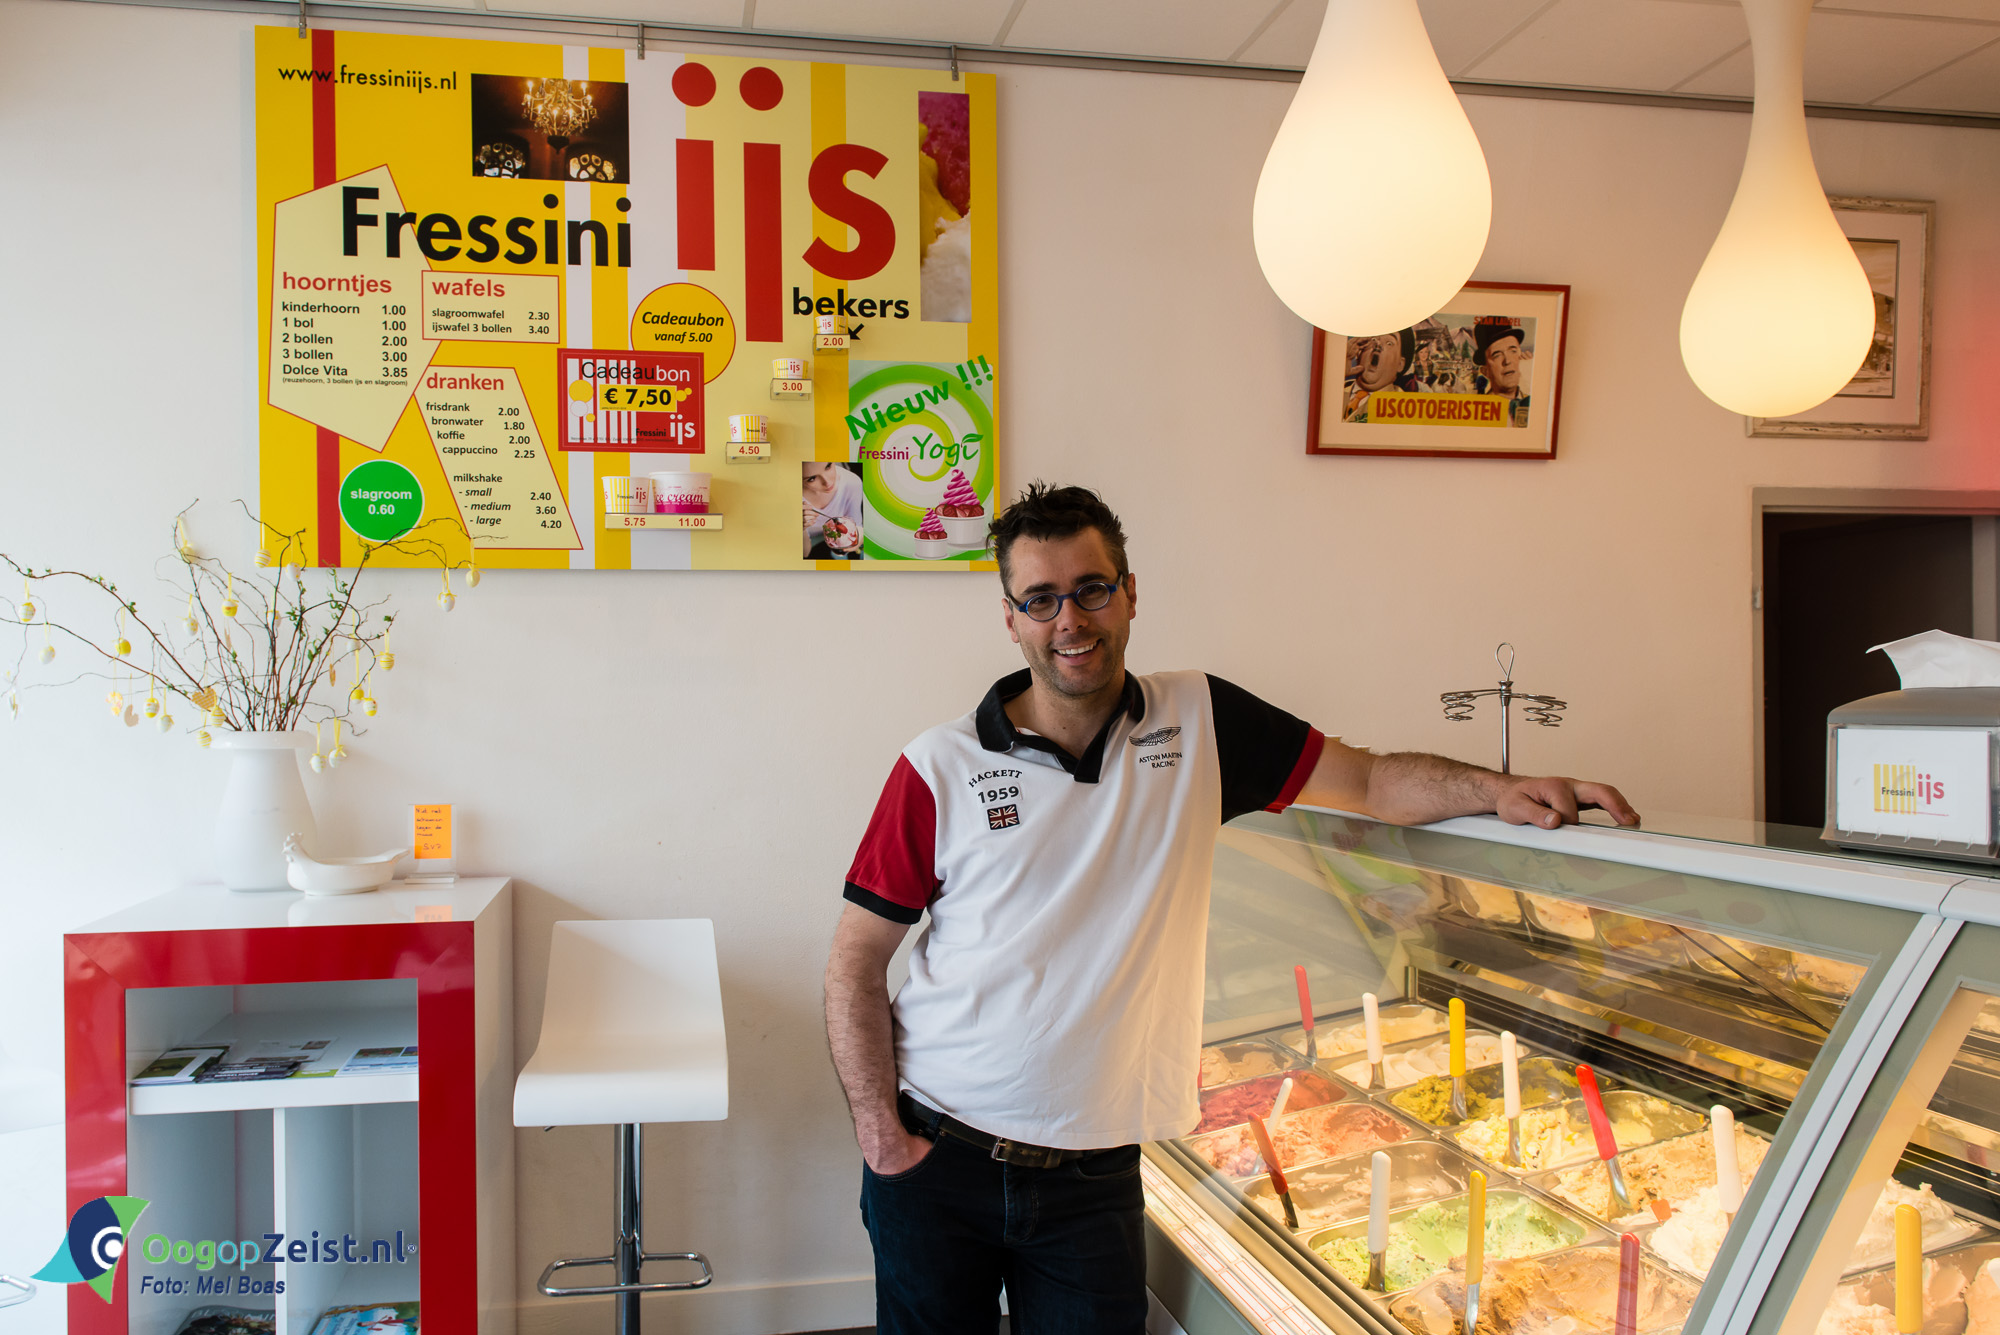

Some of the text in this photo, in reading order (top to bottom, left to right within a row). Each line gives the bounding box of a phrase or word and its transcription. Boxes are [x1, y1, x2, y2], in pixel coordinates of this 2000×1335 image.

[278, 65, 457, 93] www.fressiniijs.nl
[342, 62, 896, 342] Fressini ijs
[282, 272, 392, 297] hoorntjes
[432, 279, 505, 297] wafels
[282, 301, 406, 315] kinderhoorn 1.00
[793, 287, 910, 318] bekers
[432, 308, 550, 320] slagroomwafel 2.30
[641, 311, 724, 327] Cadeaubon
[282, 317, 406, 331] 1 bol 1.00
[432, 321, 550, 334] ijswafel 3 bollen 3.40
[282, 333, 407, 346] 2 bollen 2.00
[654, 331, 713, 343] vanaf 5.00
[823, 337, 844, 346] 2.00
[282, 348, 407, 362] 3 bollen 3.00
[282, 364, 408, 378] Dolce Vita 3.85
[581, 361, 690, 382] Cadeaubon
[426, 373, 505, 391] dranken
[782, 382, 803, 391] 3.00
[604, 388, 671, 408] € 7,50
[844, 354, 993, 441] Nieuw !!!
[426, 402, 520, 416] frisdrank 2.00
[1376, 397, 1501, 422] IJSCOTOERISTEN
[431, 416, 525, 430] bronwater 1.80
[635, 414, 696, 445] Fressini ijs
[437, 431, 531, 444] koffie 2.00
[442, 446, 536, 458] cappuccino 2.25
[739, 446, 760, 455] 4.50
[859, 433, 984, 467] Fressini Yogi
[453, 473, 503, 482] milkshake
[350, 488, 413, 502] slagroom
[465, 488, 492, 496] small
[530, 492, 552, 500] 2.40
[636, 487, 647, 503] ijs
[667, 493, 703, 503] cream
[367, 504, 396, 515] 0.60
[470, 501, 511, 511] medium
[535, 506, 557, 515] 3.60
[476, 516, 502, 527] large
[540, 520, 562, 529] 4.20
[624, 517, 706, 527] 5.75 11.00
[1139, 754, 1160, 764] ASTON
[1151, 760, 1176, 768] RACING
[968, 769, 1023, 788] HACKETT
[978, 786, 1019, 804] 1959
[1881, 773, 1945, 805] Fressini ijs
